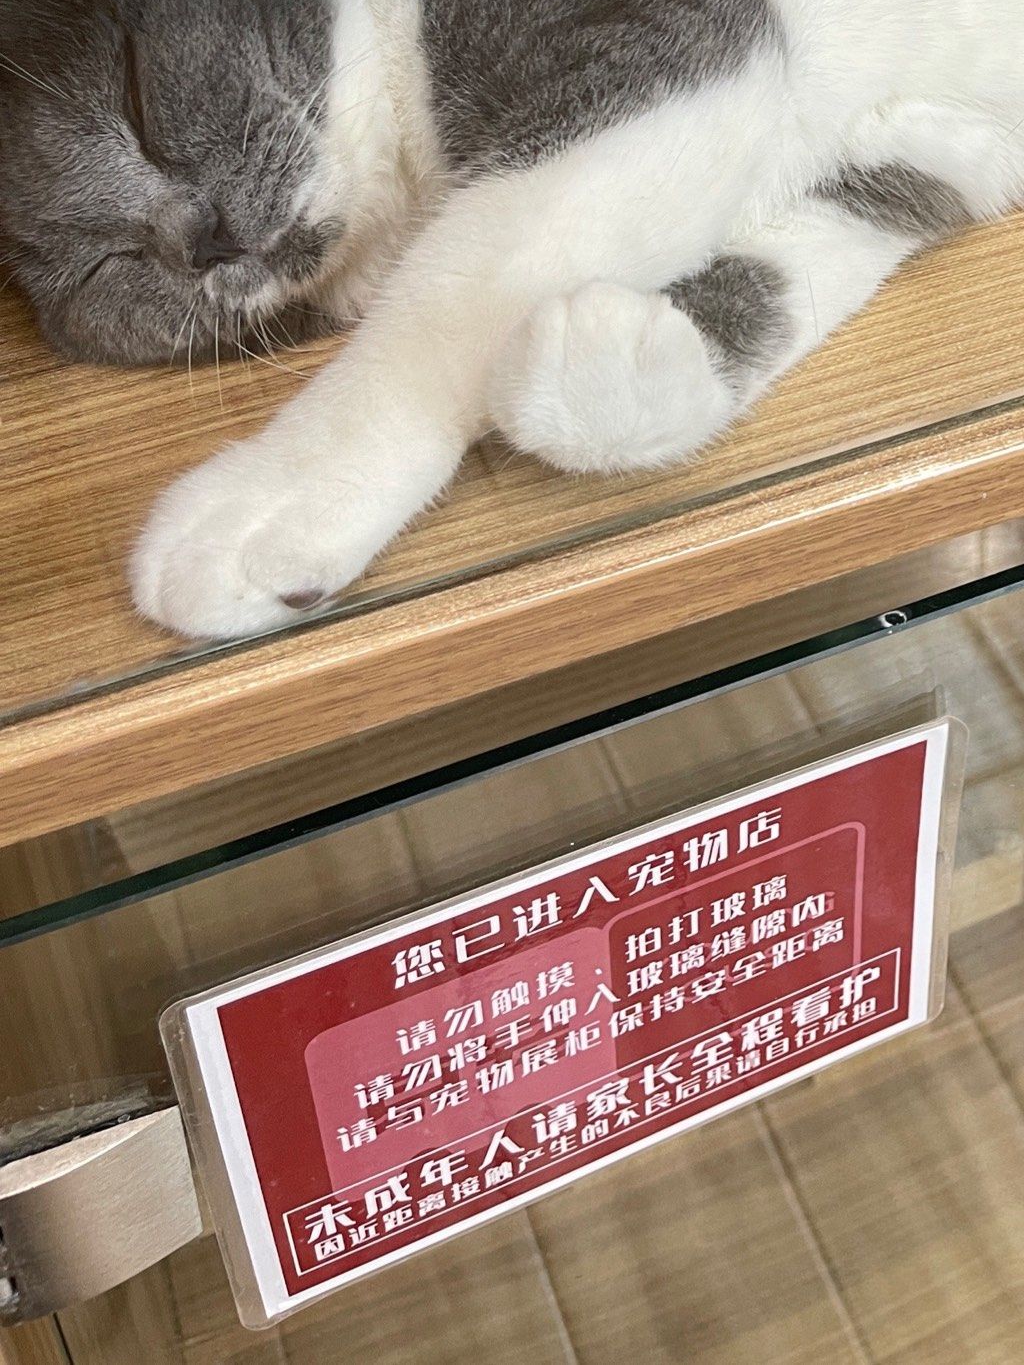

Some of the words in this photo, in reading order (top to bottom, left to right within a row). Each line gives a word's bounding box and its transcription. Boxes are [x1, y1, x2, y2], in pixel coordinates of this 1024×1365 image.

[353, 893, 825, 1109] 请勿将手伸入玻璃缝隙内
[391, 807, 781, 989] 您已进入宠物店
[305, 966, 880, 1244] 未成年人请家长全程看护
[314, 997, 879, 1261] 因近距离接触产生的不良后果请自行承担
[336, 917, 844, 1152] 请与宠物展柜保持安全距离
